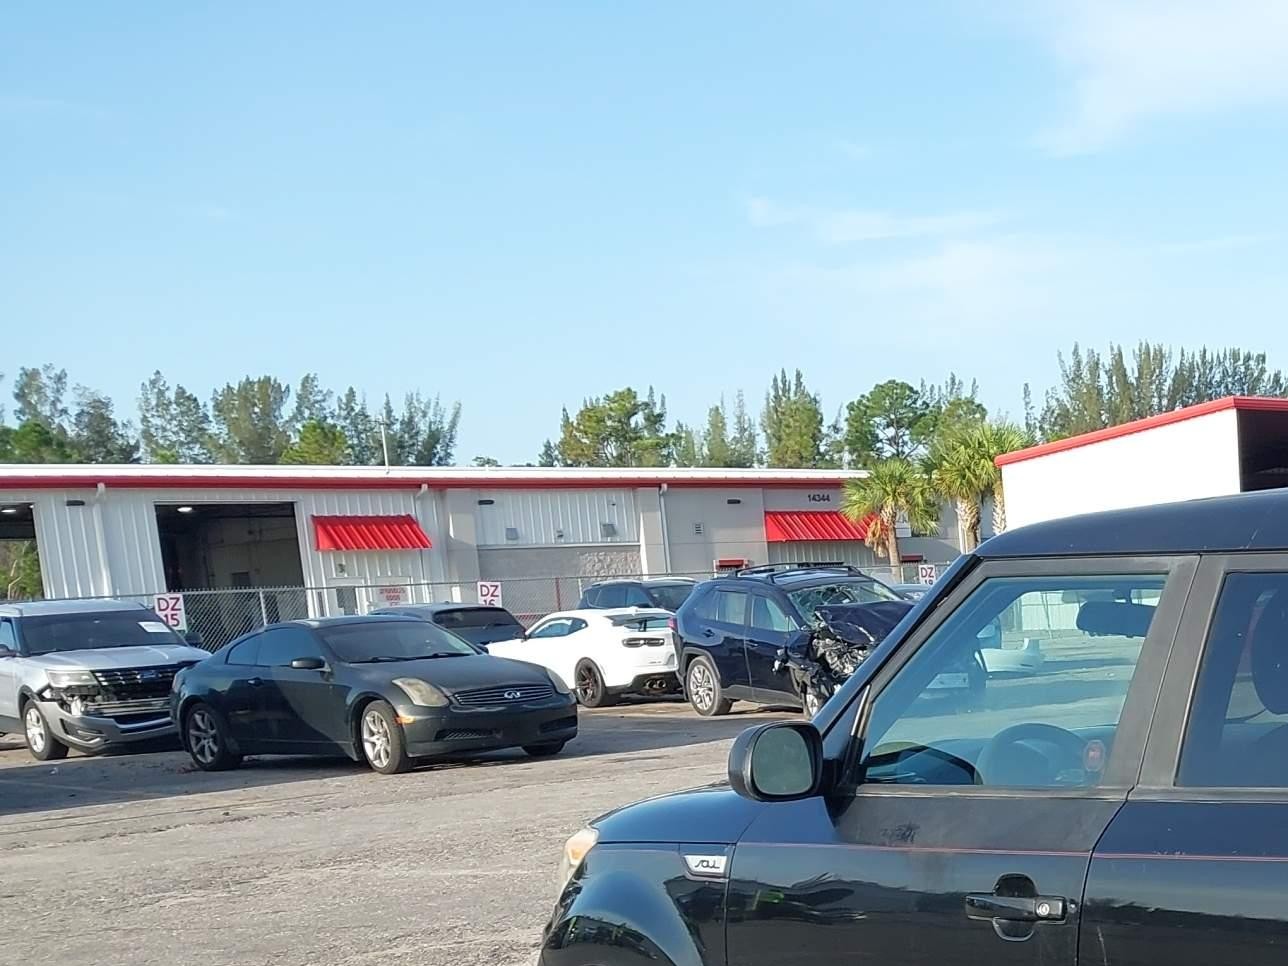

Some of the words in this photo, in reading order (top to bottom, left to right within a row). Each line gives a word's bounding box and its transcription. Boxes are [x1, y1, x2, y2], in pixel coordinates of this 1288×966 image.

[807, 493, 831, 502] 14344
[921, 567, 935, 578] DZ
[480, 584, 500, 597] DZ
[157, 597, 182, 611] DZ
[164, 613, 180, 627] 15
